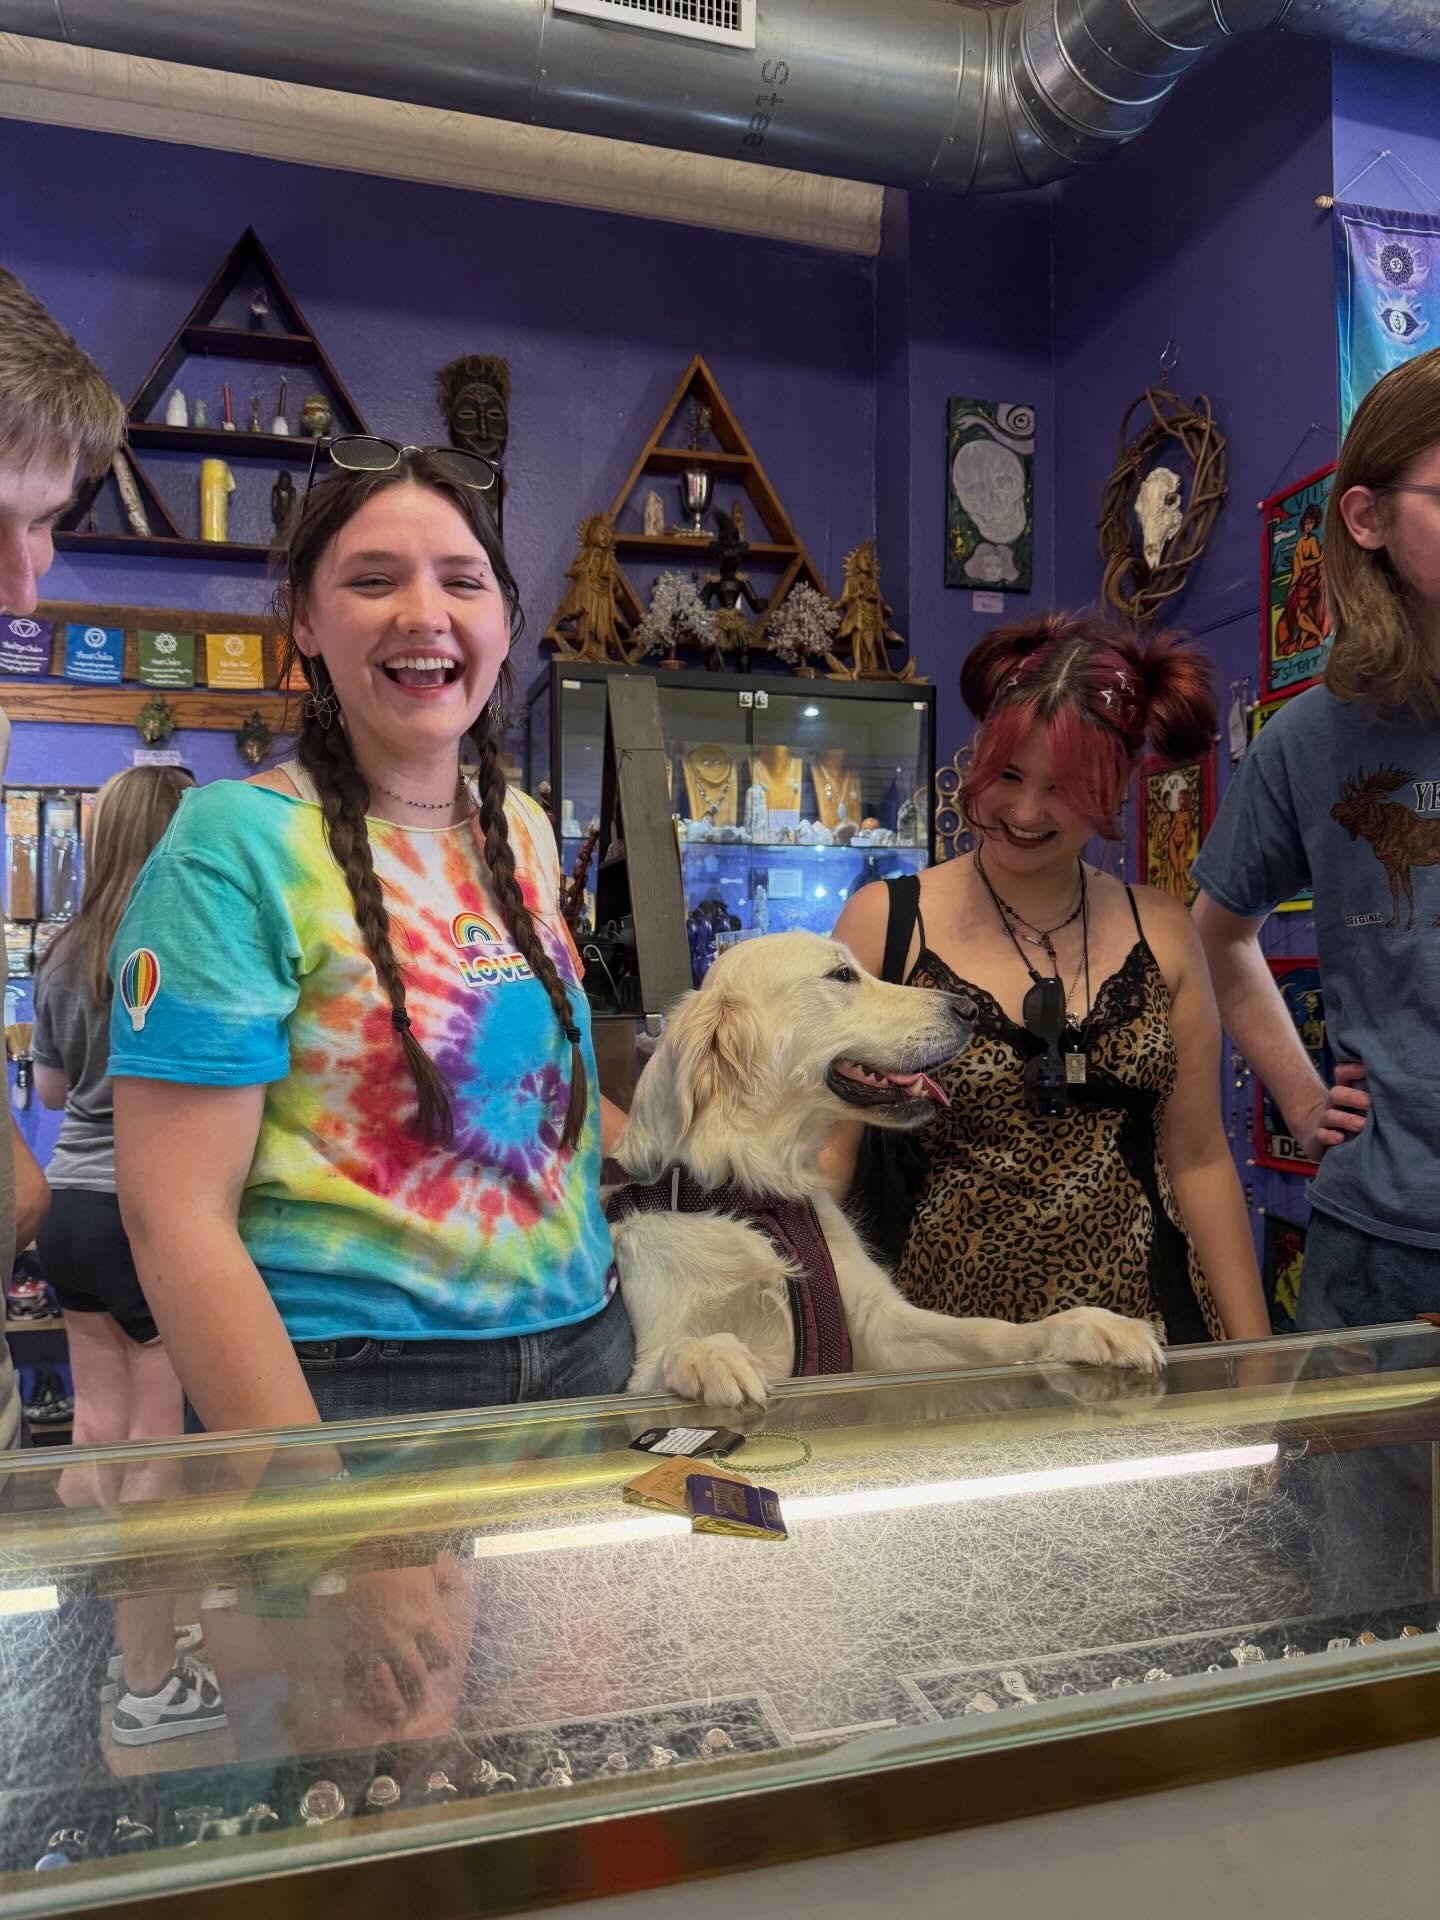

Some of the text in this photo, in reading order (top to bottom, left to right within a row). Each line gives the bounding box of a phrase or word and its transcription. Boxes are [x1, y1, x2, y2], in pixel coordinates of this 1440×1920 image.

[1413, 781, 1440, 812] YE
[457, 953, 534, 987] LOVE
[1280, 1137, 1308, 1159] DE
